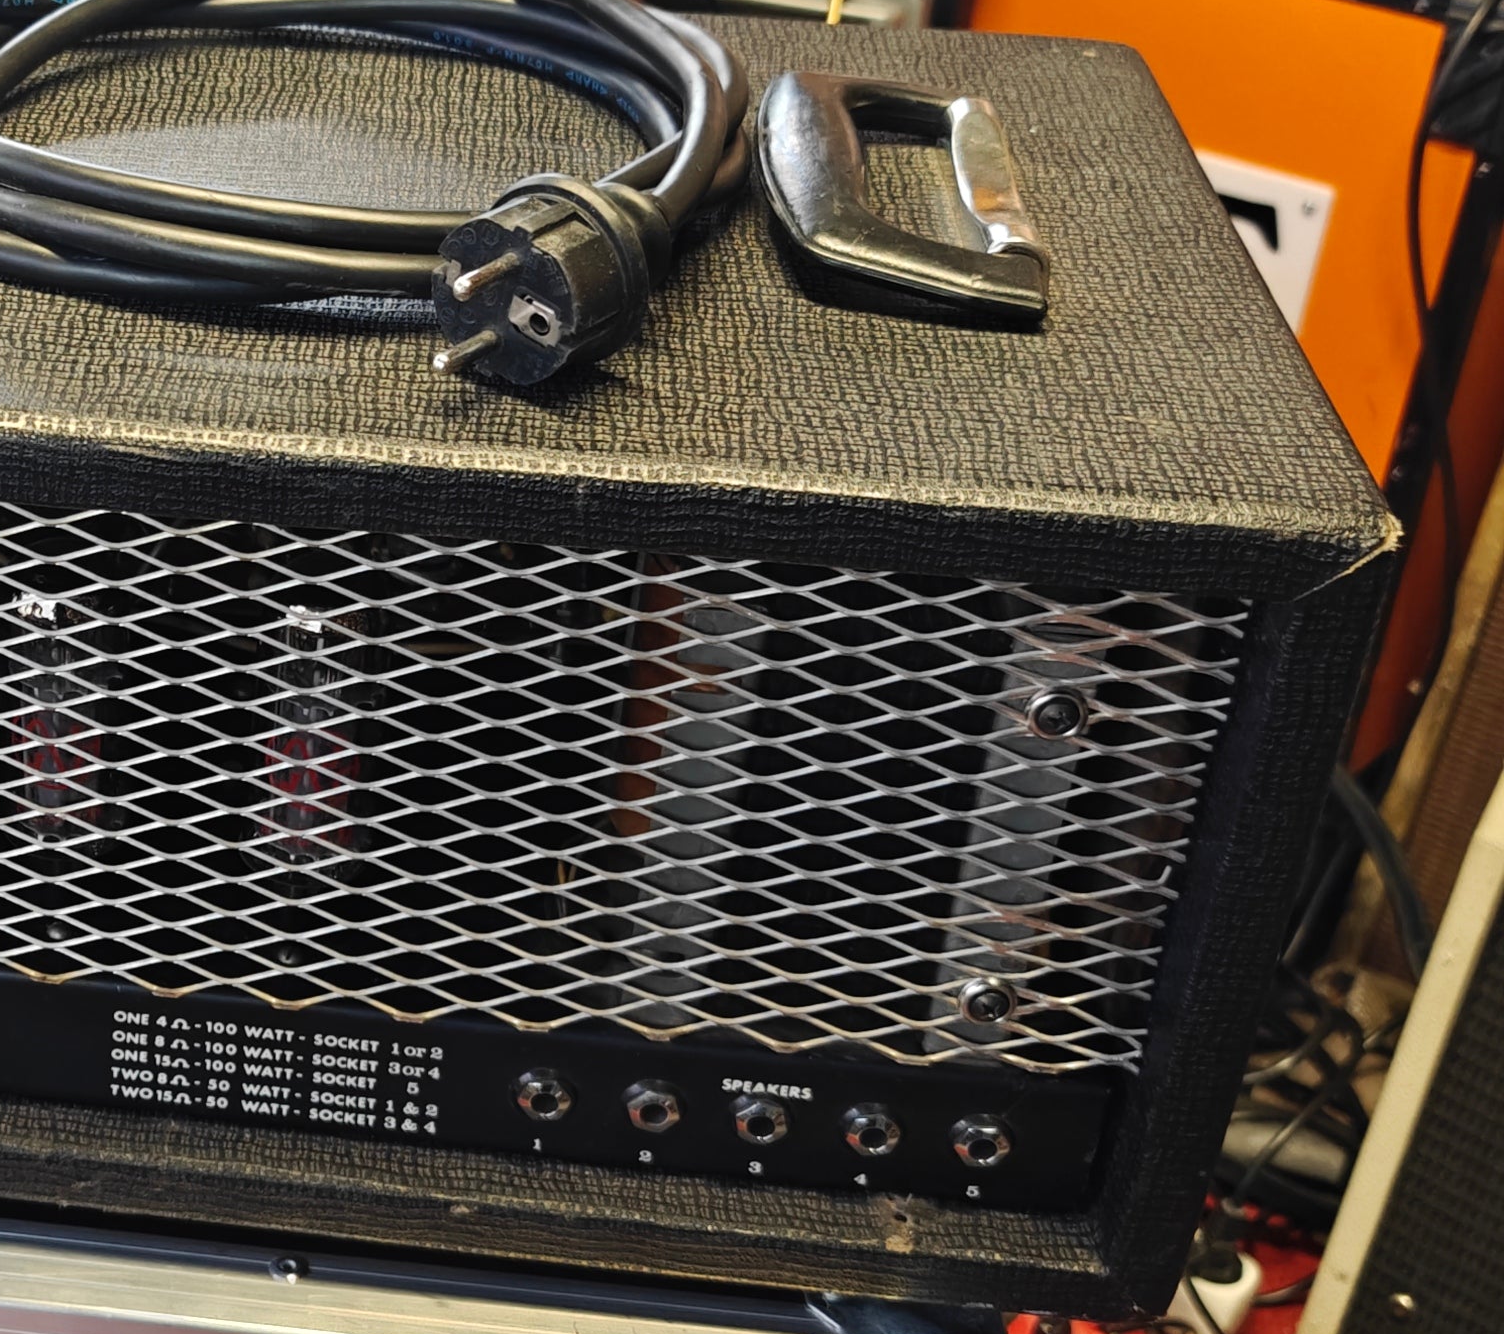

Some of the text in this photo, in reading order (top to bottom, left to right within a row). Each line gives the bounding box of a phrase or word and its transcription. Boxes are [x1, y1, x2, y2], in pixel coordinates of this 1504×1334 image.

[113, 1010, 150, 1026] ONE
[206, 1021, 238, 1035] 100
[244, 1025, 295, 1043] WATT
[313, 1033, 380, 1053] SOCKET
[391, 1042, 400, 1056] 1
[403, 1046, 427, 1059] or
[429, 1046, 443, 1060] 2
[112, 1030, 148, 1046] ONE
[205, 1041, 238, 1056] 100
[242, 1045, 294, 1063] WATT
[312, 1053, 379, 1073] SOCKET
[428, 1066, 441, 1080] 4
[111, 1048, 148, 1063] ONE
[205, 1059, 237, 1074] 100
[243, 1063, 294, 1080] WATT
[312, 1071, 377, 1090] SOCKET
[406, 1081, 420, 1095] 5
[111, 1067, 154, 1082] TWO
[207, 1078, 230, 1092] 50
[242, 1083, 291, 1099] WATT
[310, 1091, 377, 1110] SOCKET
[385, 1099, 394, 1113] 1
[403, 1101, 420, 1116] &
[425, 1104, 439, 1117] 2
[722, 1078, 813, 1100] SPEAKERS
[110, 1084, 154, 1100] TWO
[206, 1095, 229, 1109] 50
[241, 1099, 290, 1117] WATT
[309, 1107, 376, 1127] SOCKET
[384, 1116, 397, 1129] 3
[401, 1118, 418, 1132] &
[423, 1121, 437, 1134] 4
[533, 1138, 542, 1151] 1
[639, 1150, 652, 1162] 2
[748, 1161, 762, 1174] 3
[853, 1173, 867, 1186] 4
[966, 1185, 980, 1198] 5
